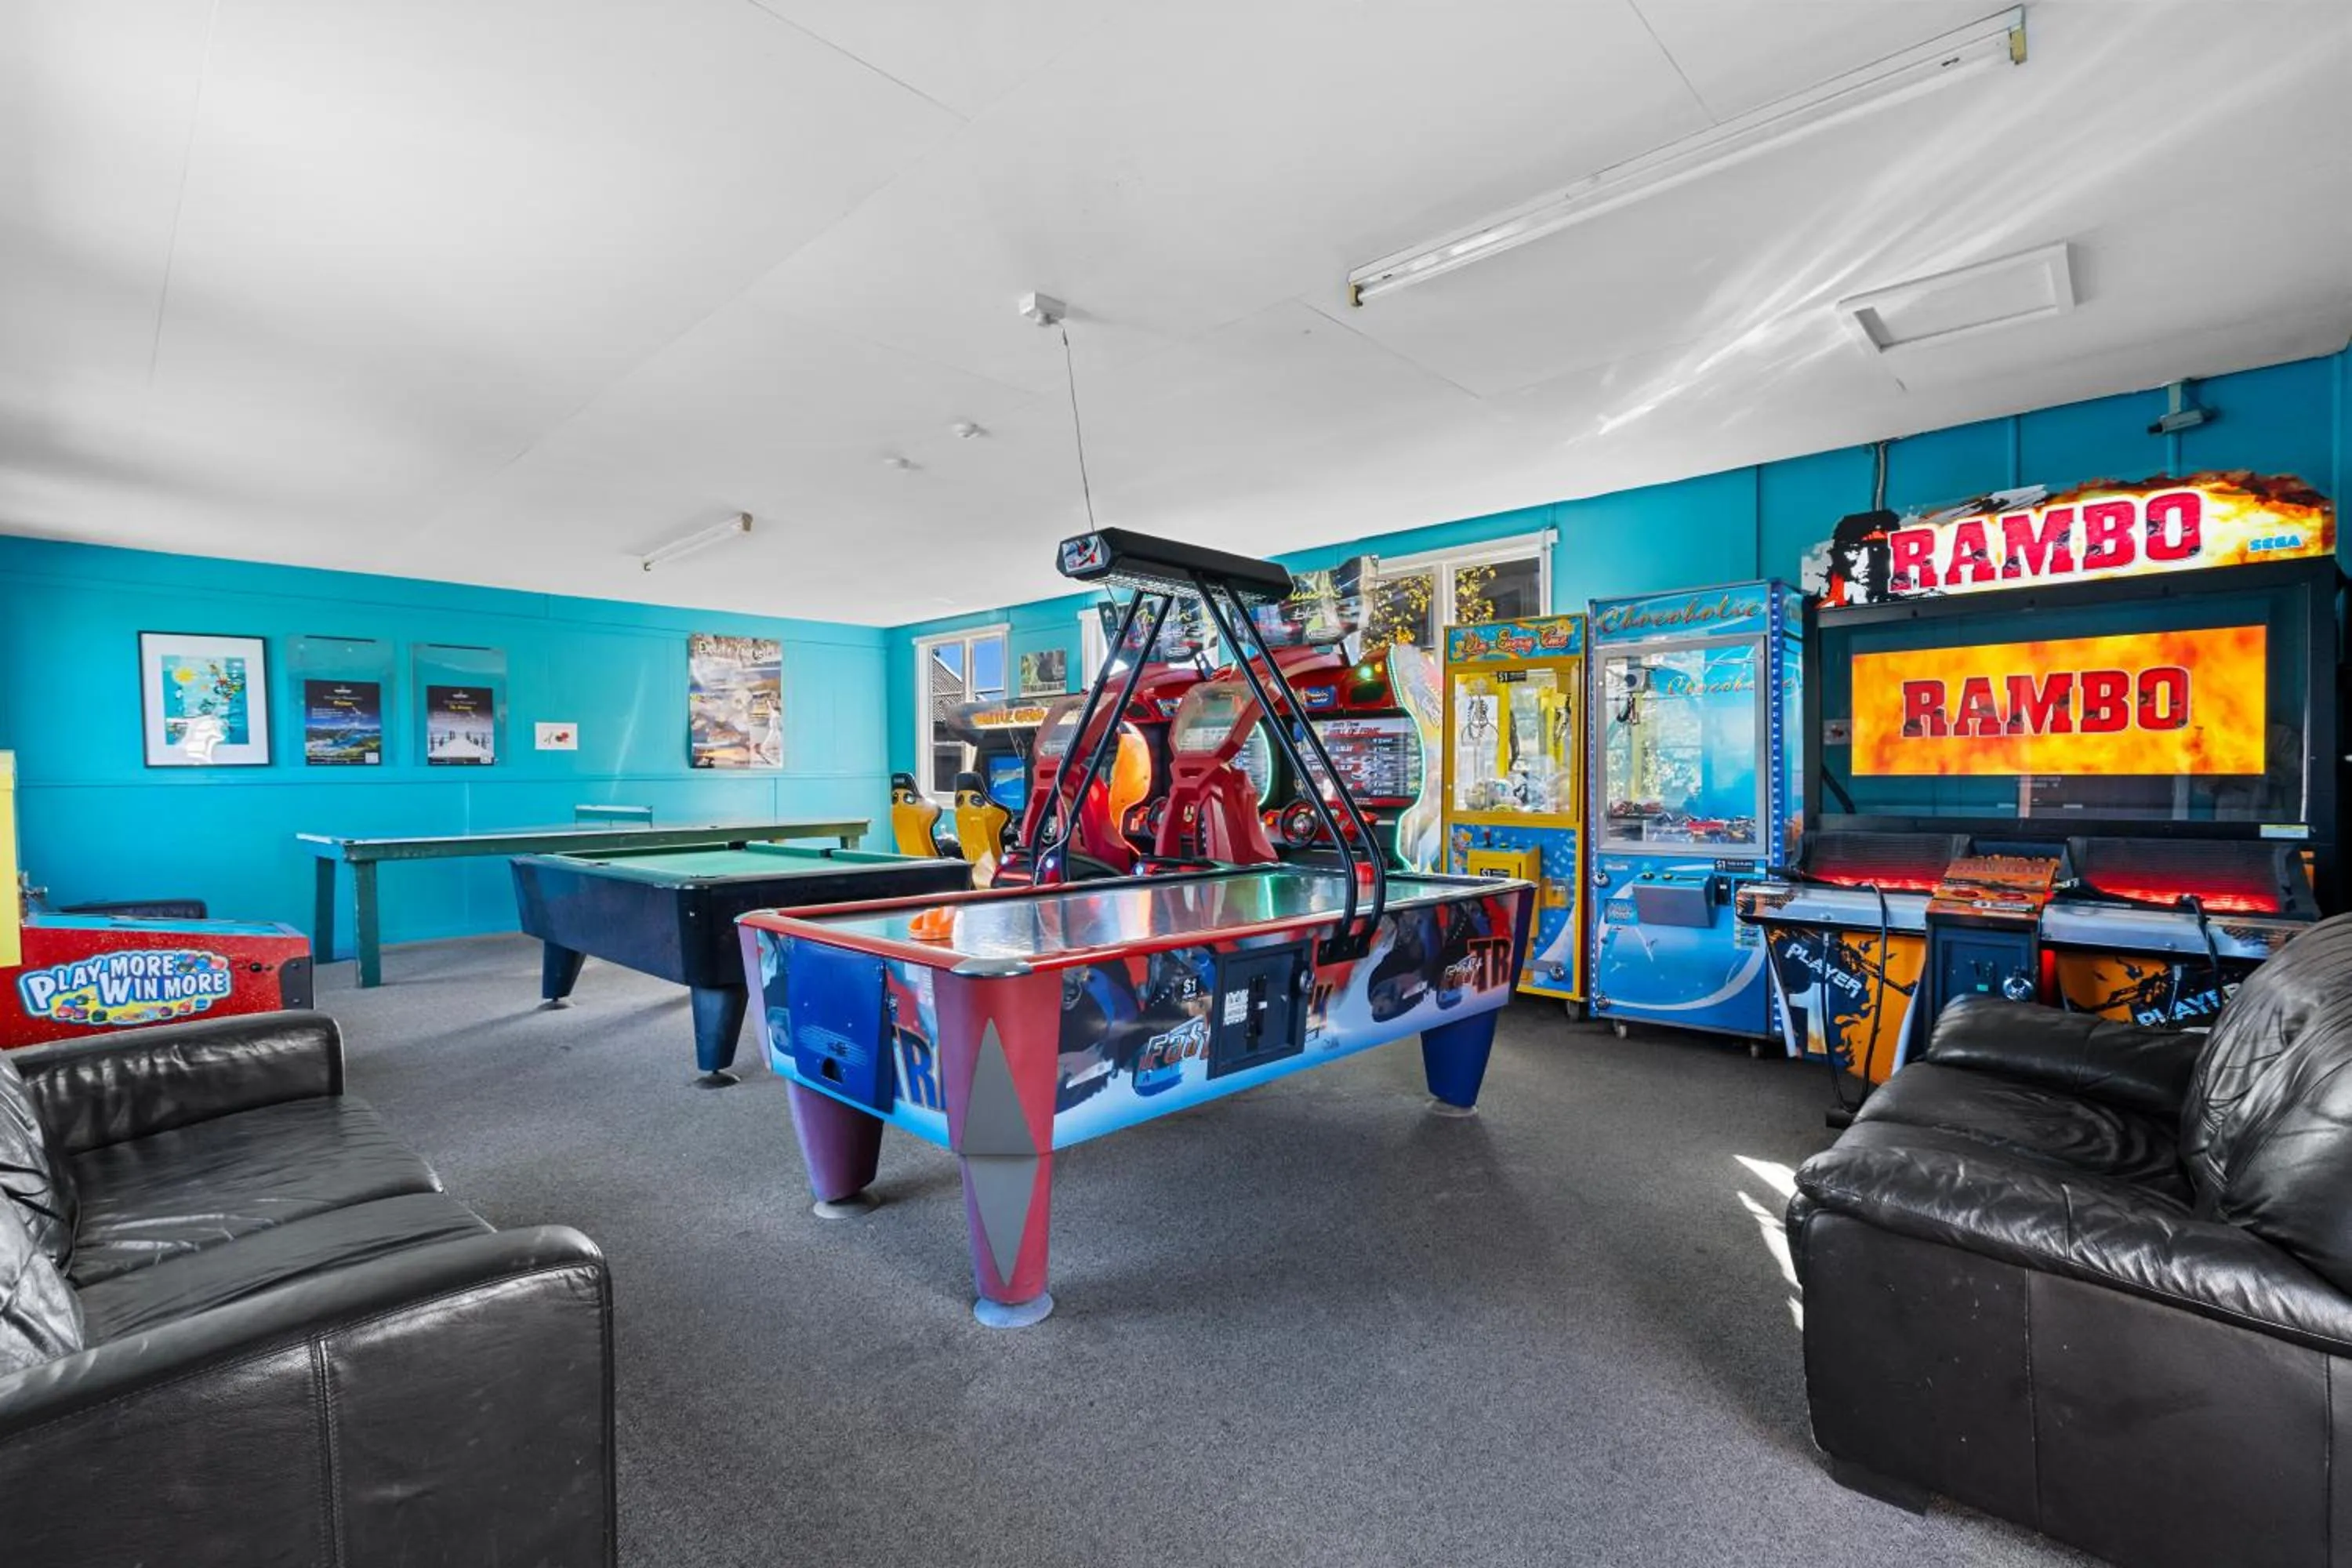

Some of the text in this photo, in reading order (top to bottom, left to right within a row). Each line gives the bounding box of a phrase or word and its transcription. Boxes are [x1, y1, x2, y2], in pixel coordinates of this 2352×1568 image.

[1889, 492, 2201, 592] RAMBO
[2249, 535, 2301, 551] SEGA
[1596, 593, 1761, 633] Chocoholic
[1903, 666, 2190, 737] RAMBO
[27, 954, 175, 1010] PLAY MORE
[99, 972, 226, 1005] WIN MORE
[1183, 978, 1197, 993] $1
[1784, 942, 1864, 1000] PLAYER
[1788, 982, 1829, 1054] 1
